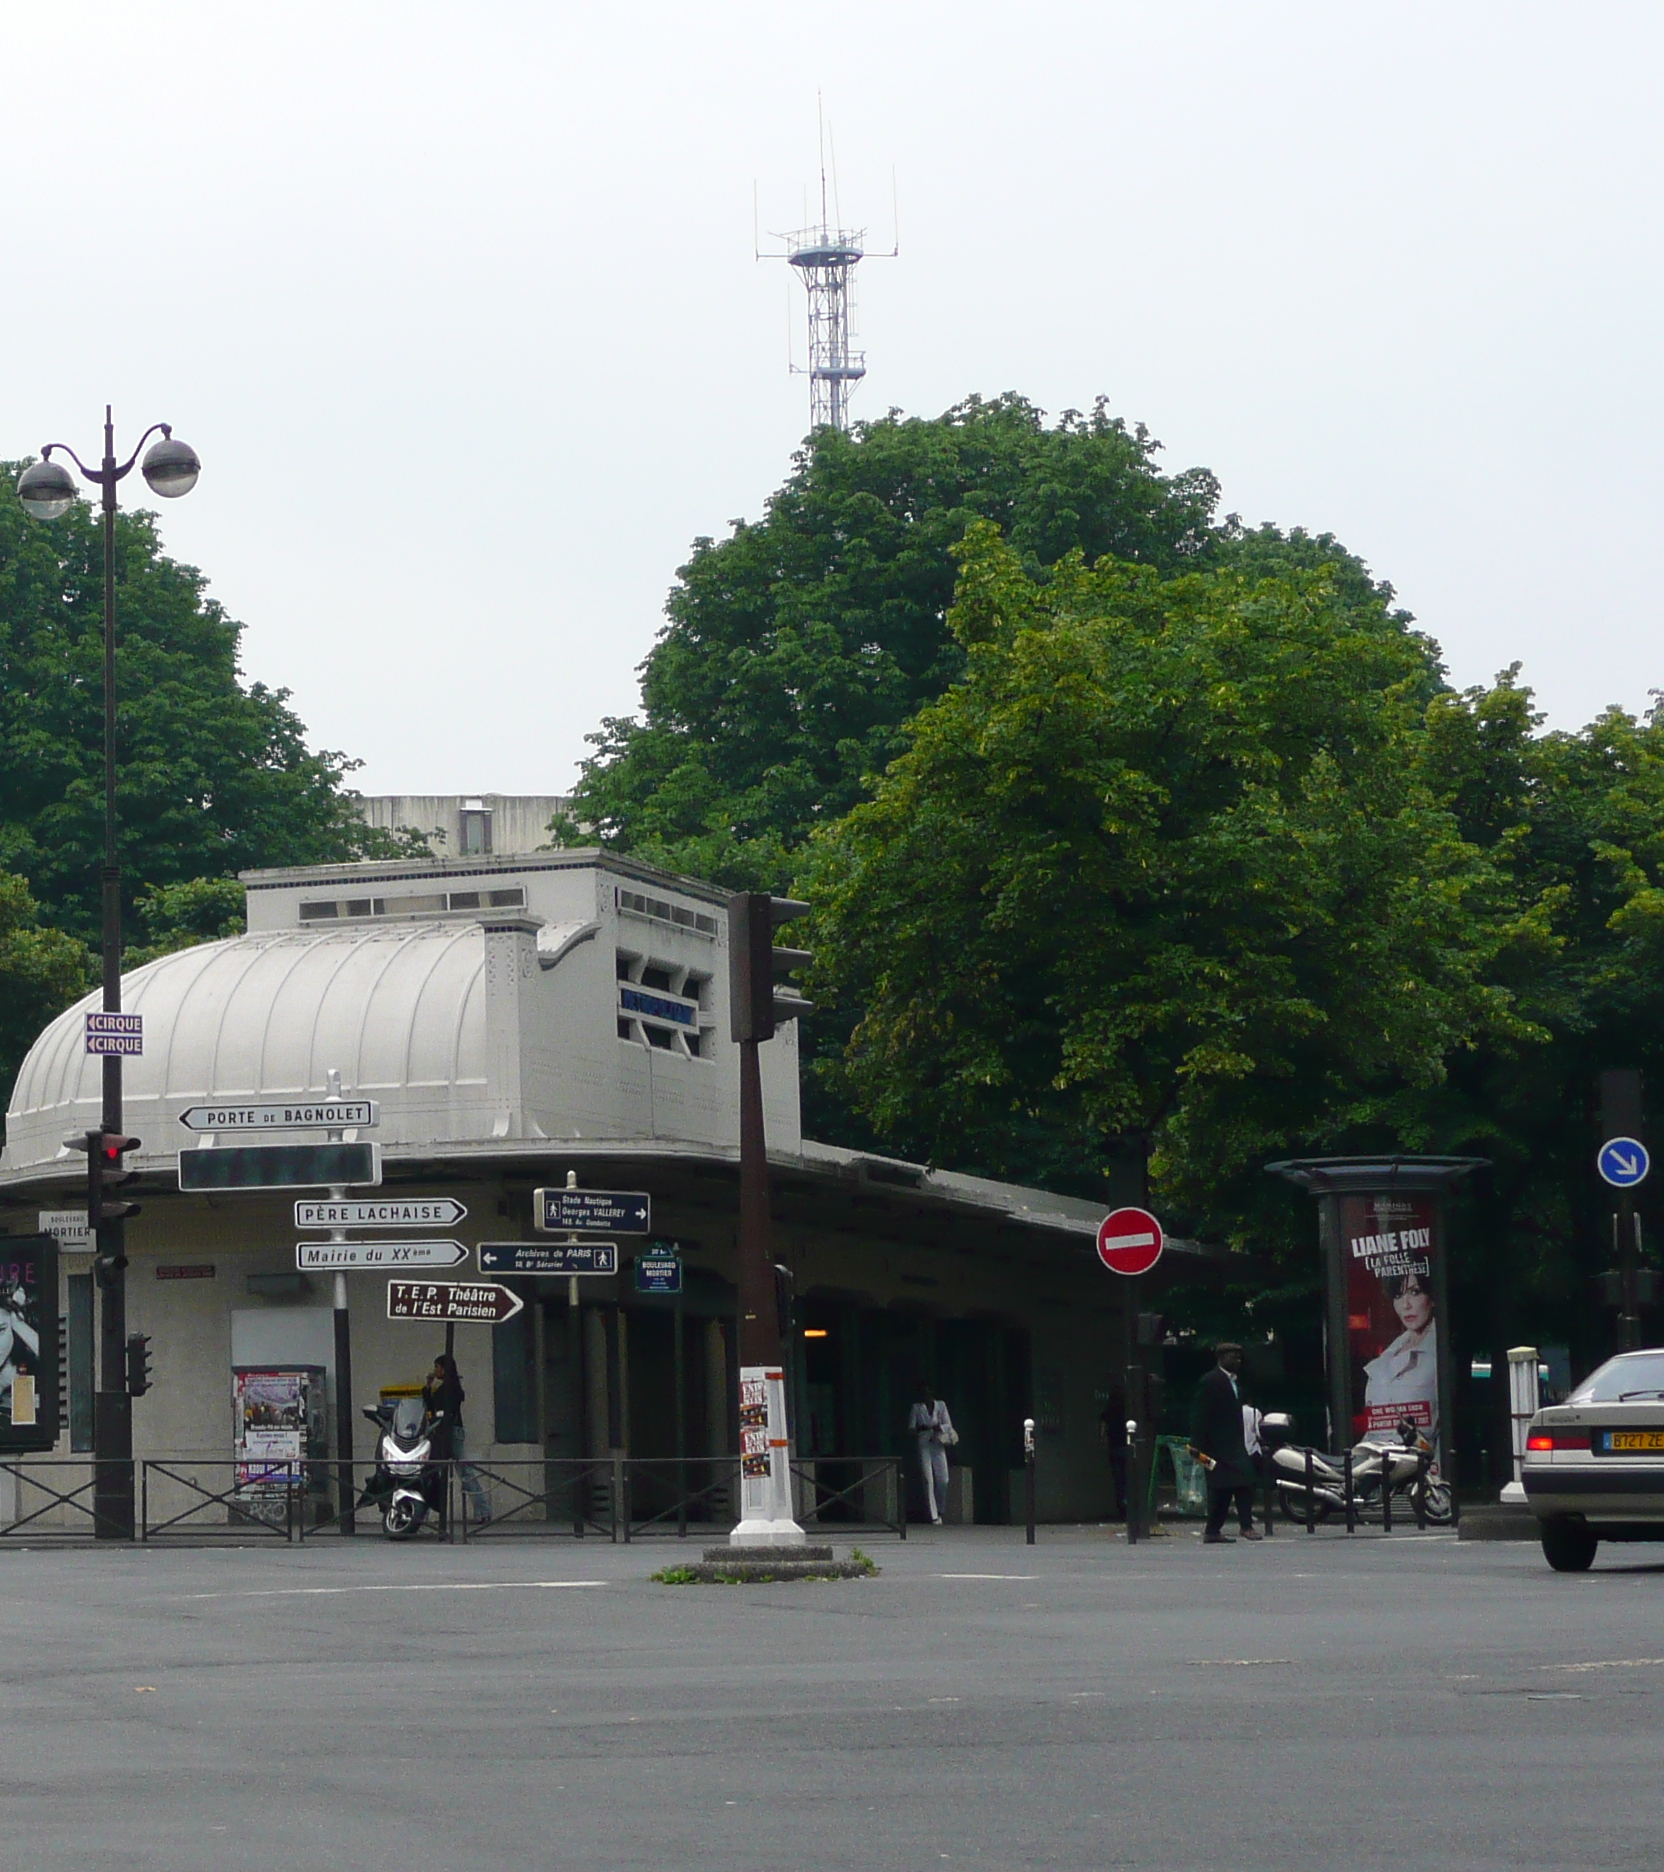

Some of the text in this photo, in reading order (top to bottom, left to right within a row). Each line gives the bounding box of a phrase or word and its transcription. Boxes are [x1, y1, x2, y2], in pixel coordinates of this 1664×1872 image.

[96, 1016, 141, 1032] CIRQUE
[96, 1037, 141, 1053] CIRQUE
[207, 1107, 363, 1125] PORTE DE BAGNOLET
[562, 1196, 612, 1206] Stade Nautique
[305, 1205, 442, 1221] PÈRE LACHAISE
[562, 1207, 626, 1218] Georges VALLEREY
[1351, 1227, 1430, 1258] LIANE FOLY
[307, 1250, 357, 1262] Mairie
[366, 1249, 382, 1261] du
[515, 1249, 592, 1258] Archives de PARIS
[1383, 1252, 1410, 1265] FOLLE
[642, 1261, 677, 1270] BOULEVARD
[645, 1269, 673, 1277] MORTIER
[448, 1287, 496, 1301] Théâtre
[395, 1301, 496, 1317] de l'Est Parisien
